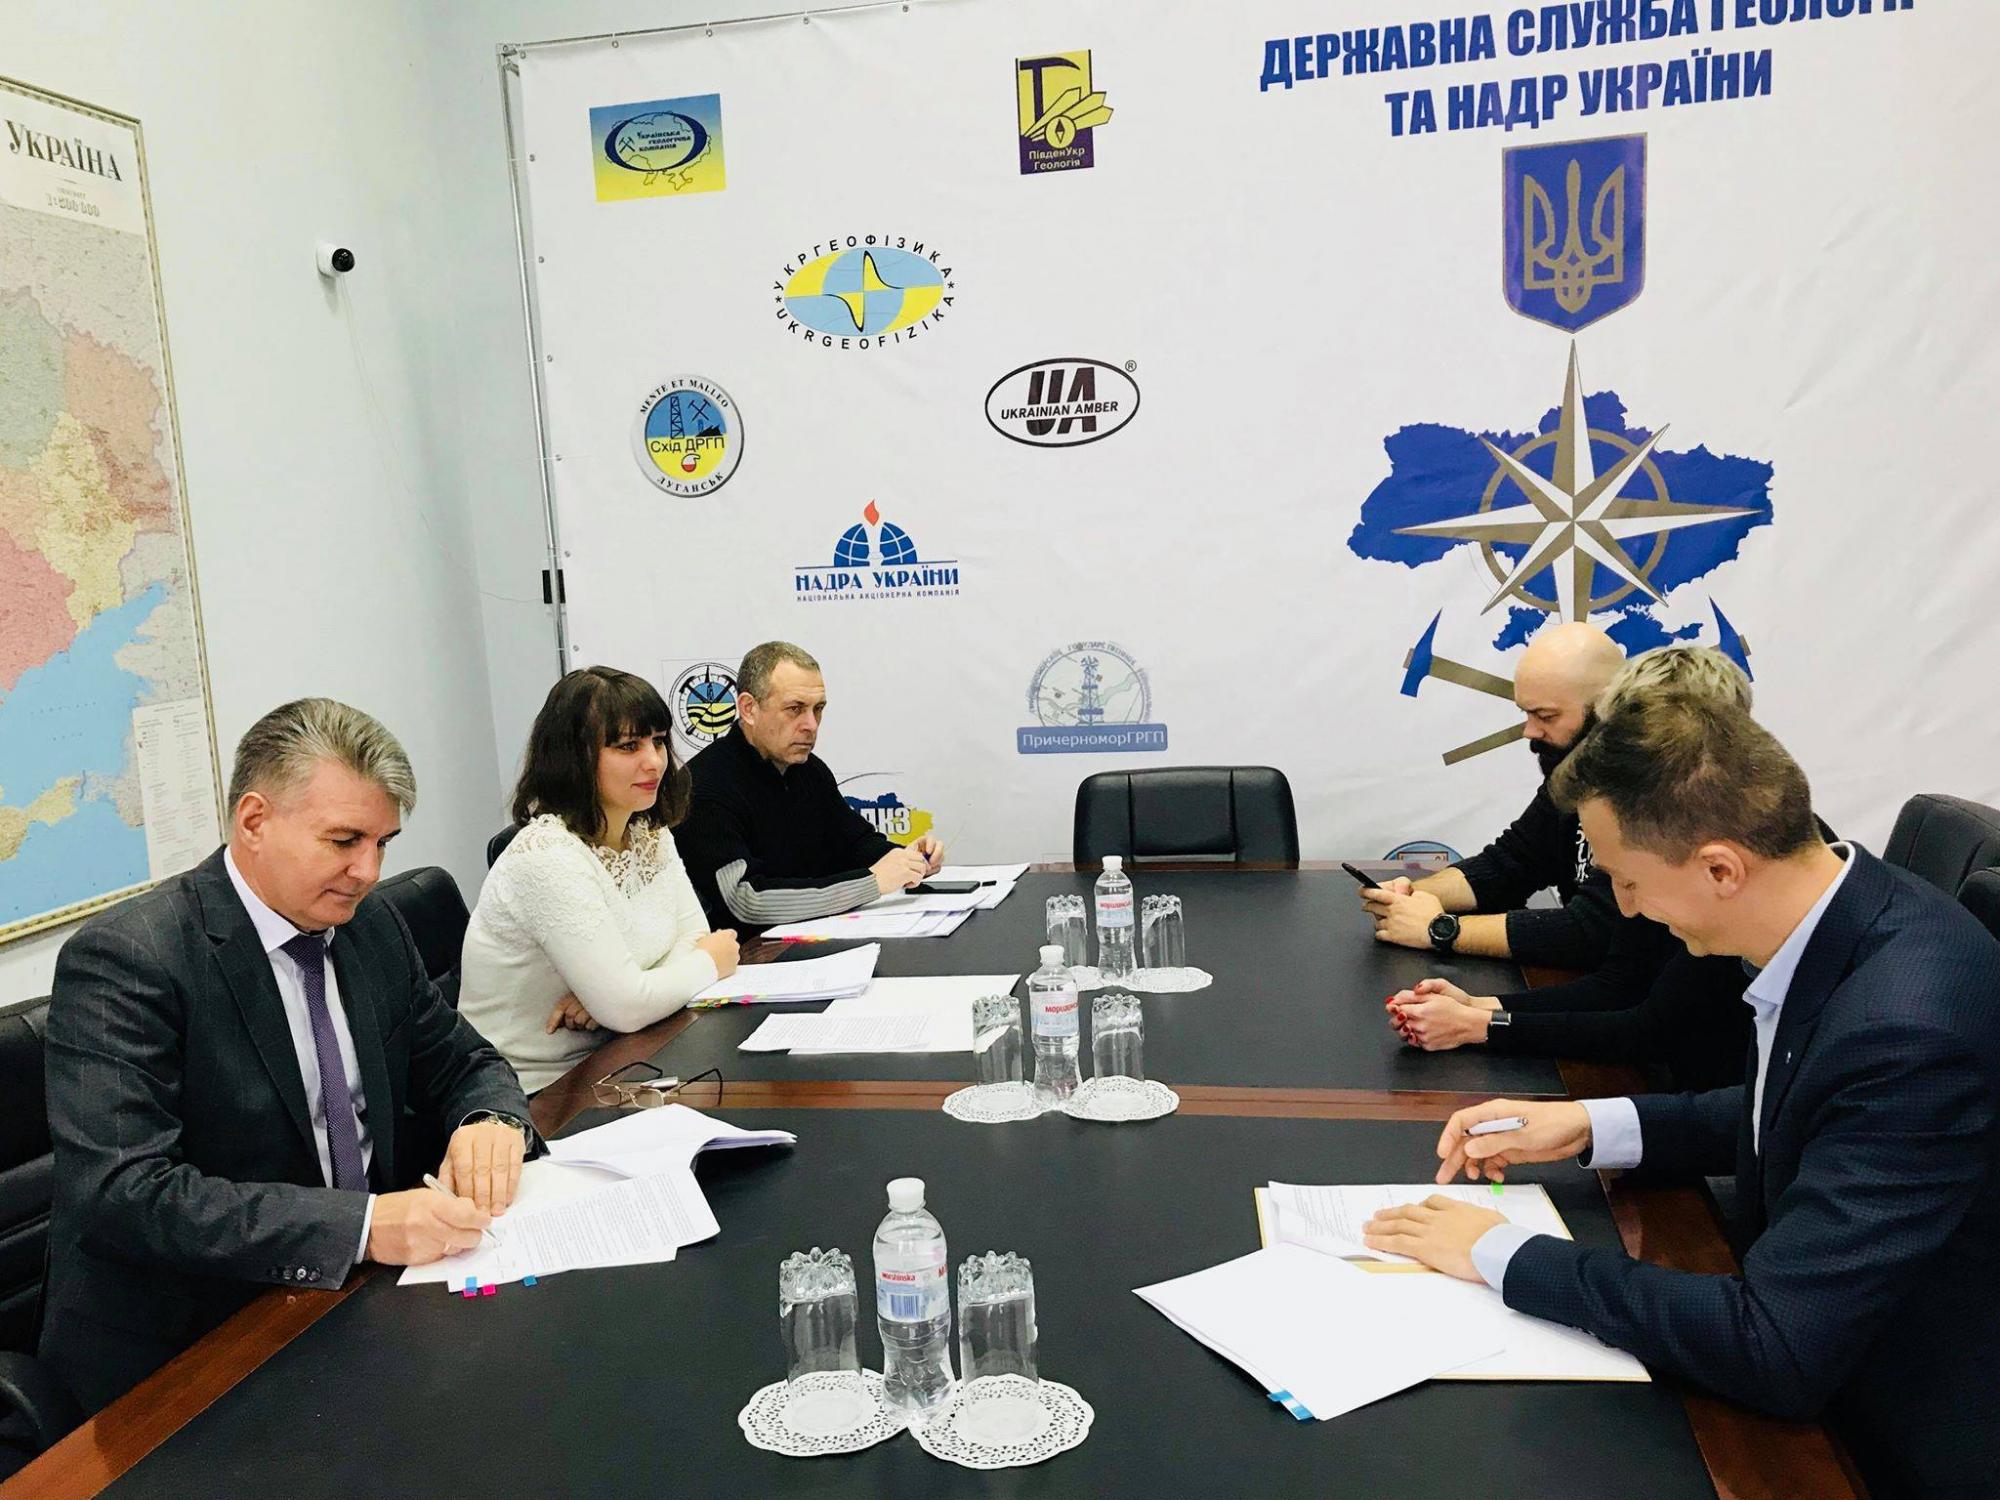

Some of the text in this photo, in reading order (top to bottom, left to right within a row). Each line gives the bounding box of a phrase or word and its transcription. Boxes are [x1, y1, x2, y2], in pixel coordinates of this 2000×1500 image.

[1260, 14, 1496, 92] ДЕРЖАВНА
[1507, 0, 1699, 57] СЛУЖБА
[1385, 47, 1772, 137] ТА НАДР УКРАЇНИ
[4, 119, 122, 182] УКРАЇНА
[1029, 146, 1085, 160] ПівденУкр
[1034, 158, 1081, 170] Геологія
[773, 234, 953, 291] УКРГЕОФІЗИКА
[776, 295, 954, 350] UKRGEOFIZIKA
[640, 379, 729, 414] MENTE ET MALLEO
[1001, 401, 1119, 420] UKRAINIAN AMBER
[650, 437, 725, 454] Схід ДРГП
[656, 471, 723, 493] ЛУГАНСЬК
[795, 565, 959, 592] НАДРА УКРАЇНИ
[797, 589, 960, 602] НАЦІОНАЛЬНА АКЦІОНЕРНА КОМПАНІЯ
[1022, 731, 1164, 748] ПричерноморГРГП
